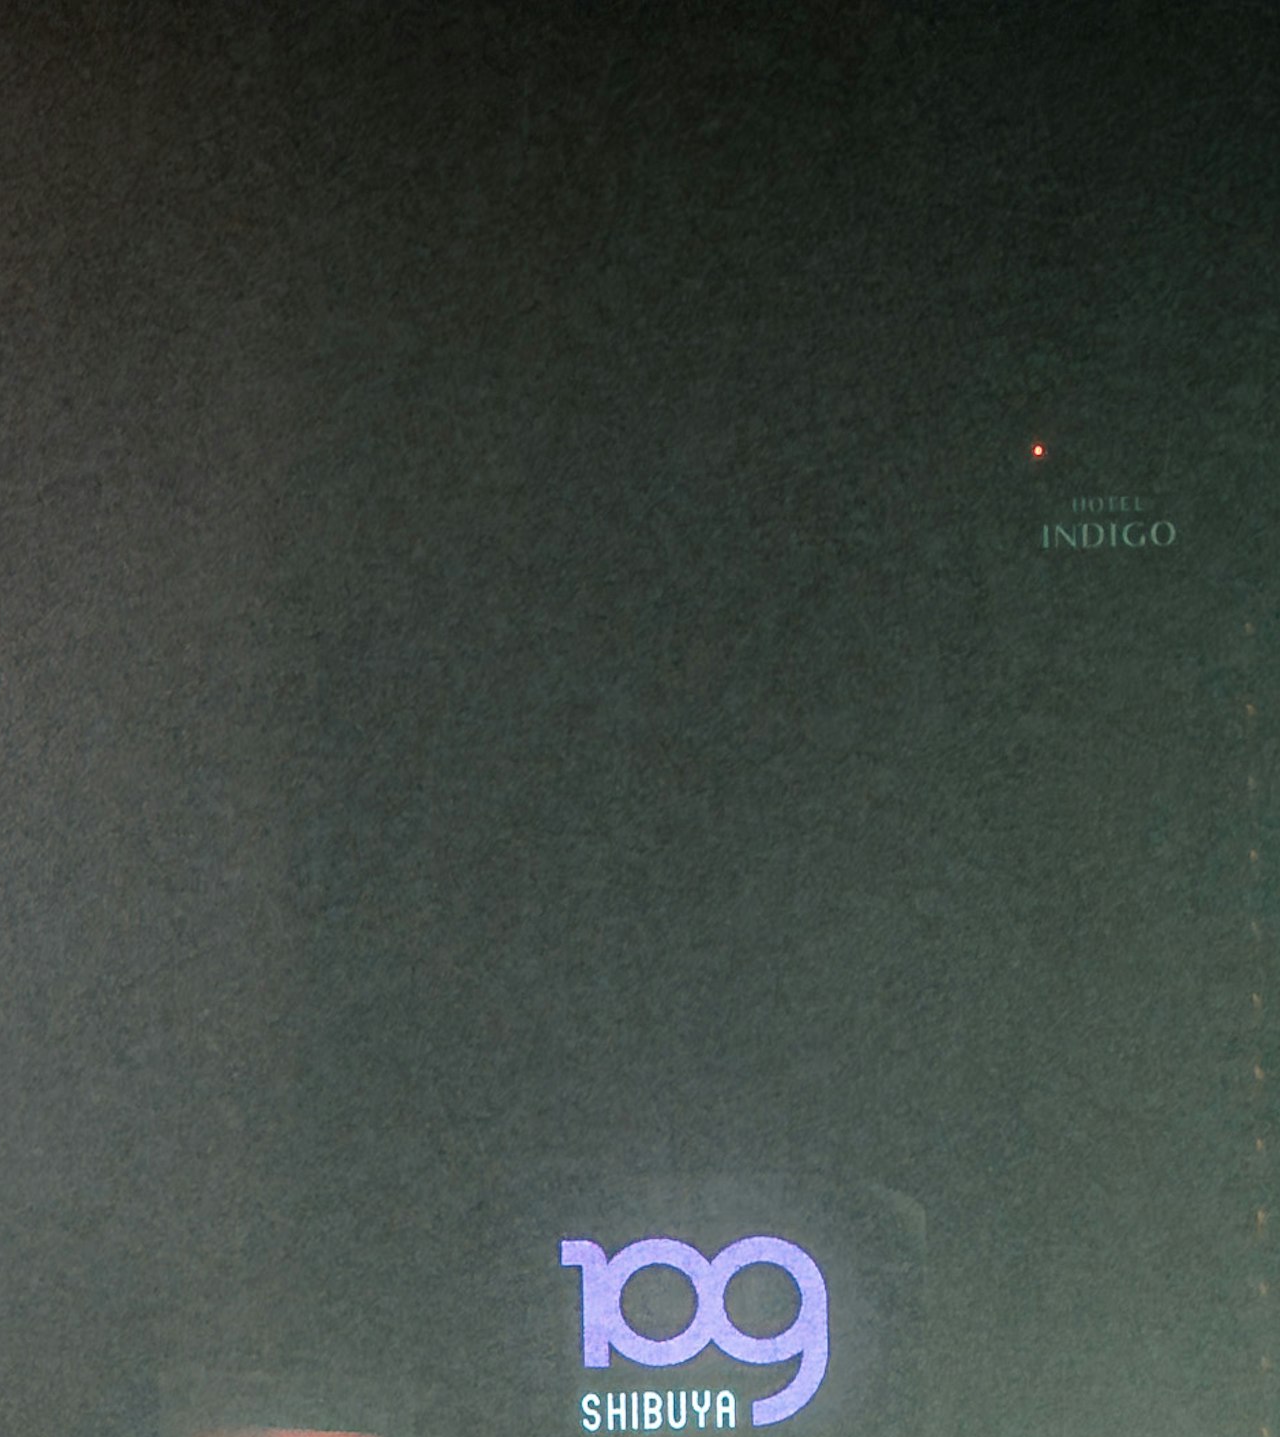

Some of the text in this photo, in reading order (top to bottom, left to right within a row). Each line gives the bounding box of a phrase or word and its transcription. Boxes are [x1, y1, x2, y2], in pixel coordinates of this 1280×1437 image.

[1072, 497, 1144, 513] HOTEL
[1041, 520, 1177, 549] INDIGO
[560, 1235, 829, 1426] 109
[581, 1390, 737, 1430] SHIBUYA
